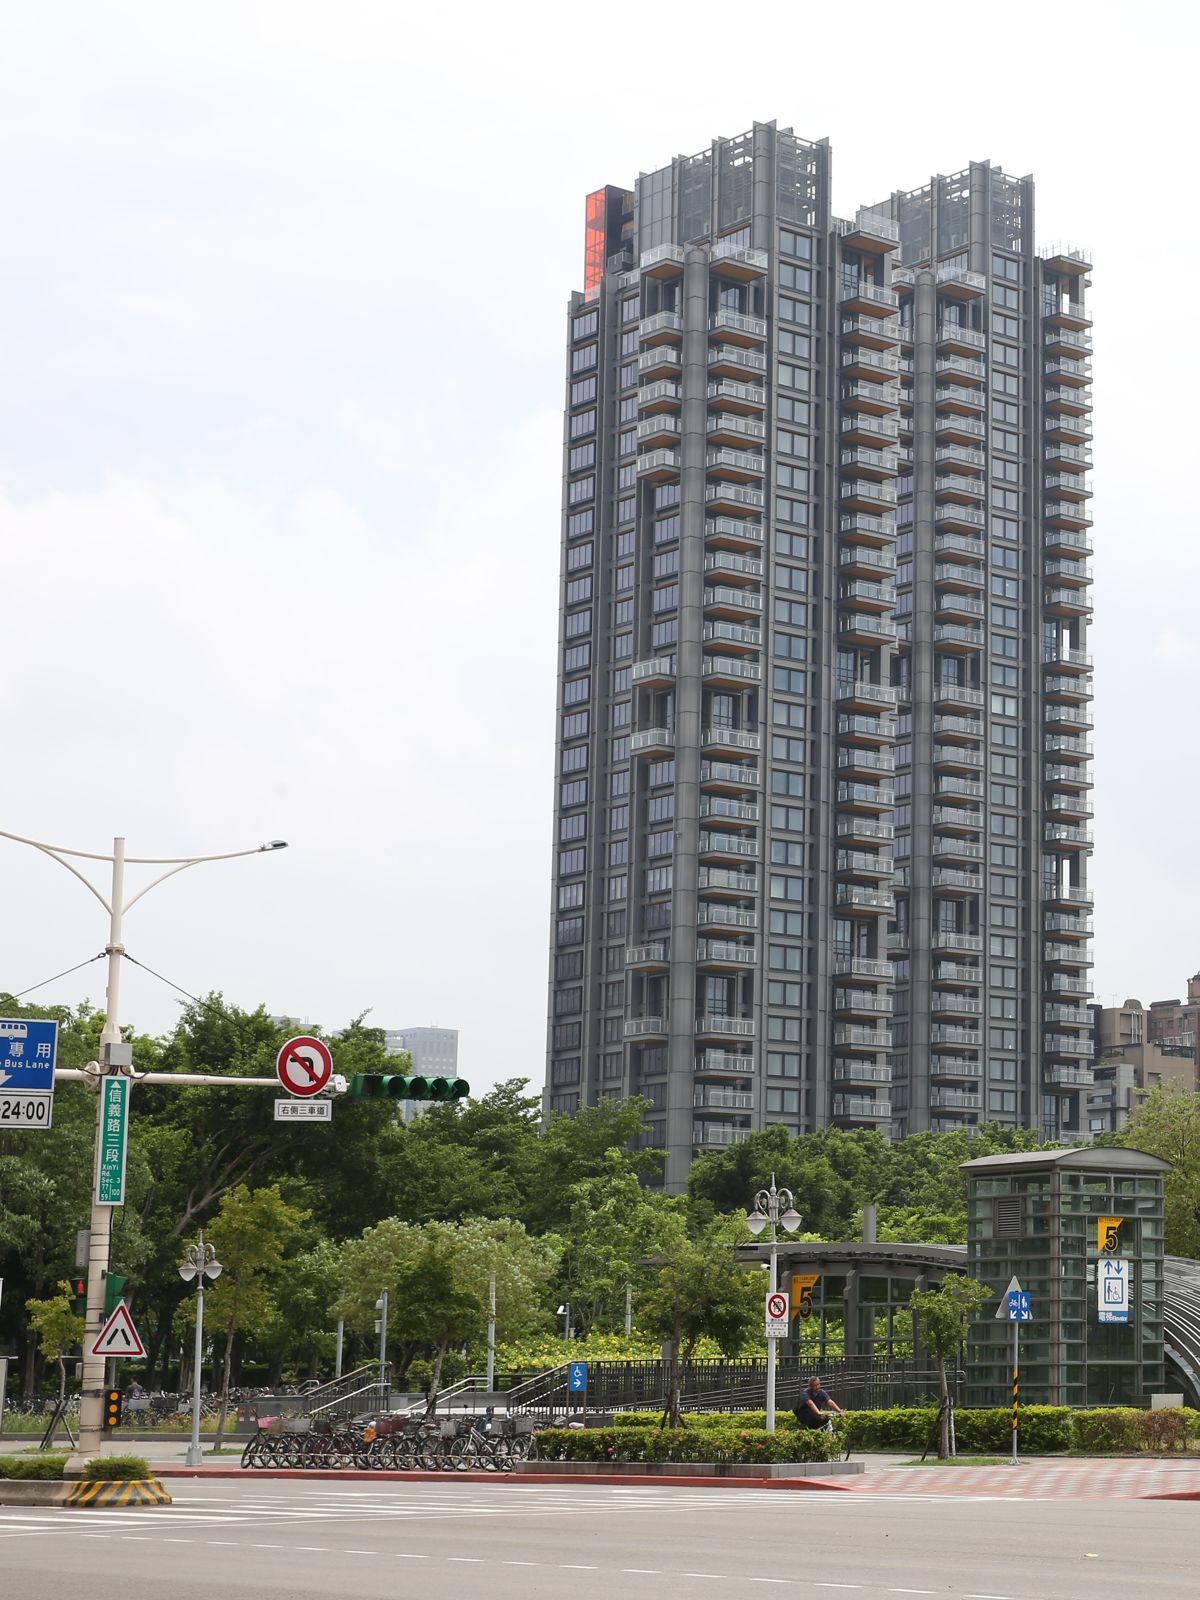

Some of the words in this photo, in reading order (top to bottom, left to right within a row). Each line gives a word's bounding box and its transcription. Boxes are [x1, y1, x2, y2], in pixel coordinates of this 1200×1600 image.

[9, 1042, 51, 1059] 專用
[4, 1059, 23, 1068] Bus
[25, 1060, 50, 1069] Lane
[281, 1105, 325, 1115] 右側三車道
[105, 1088, 122, 1162] 信義路三段
[1105, 1226, 1118, 1252] 5
[799, 1286, 813, 1320] 5
